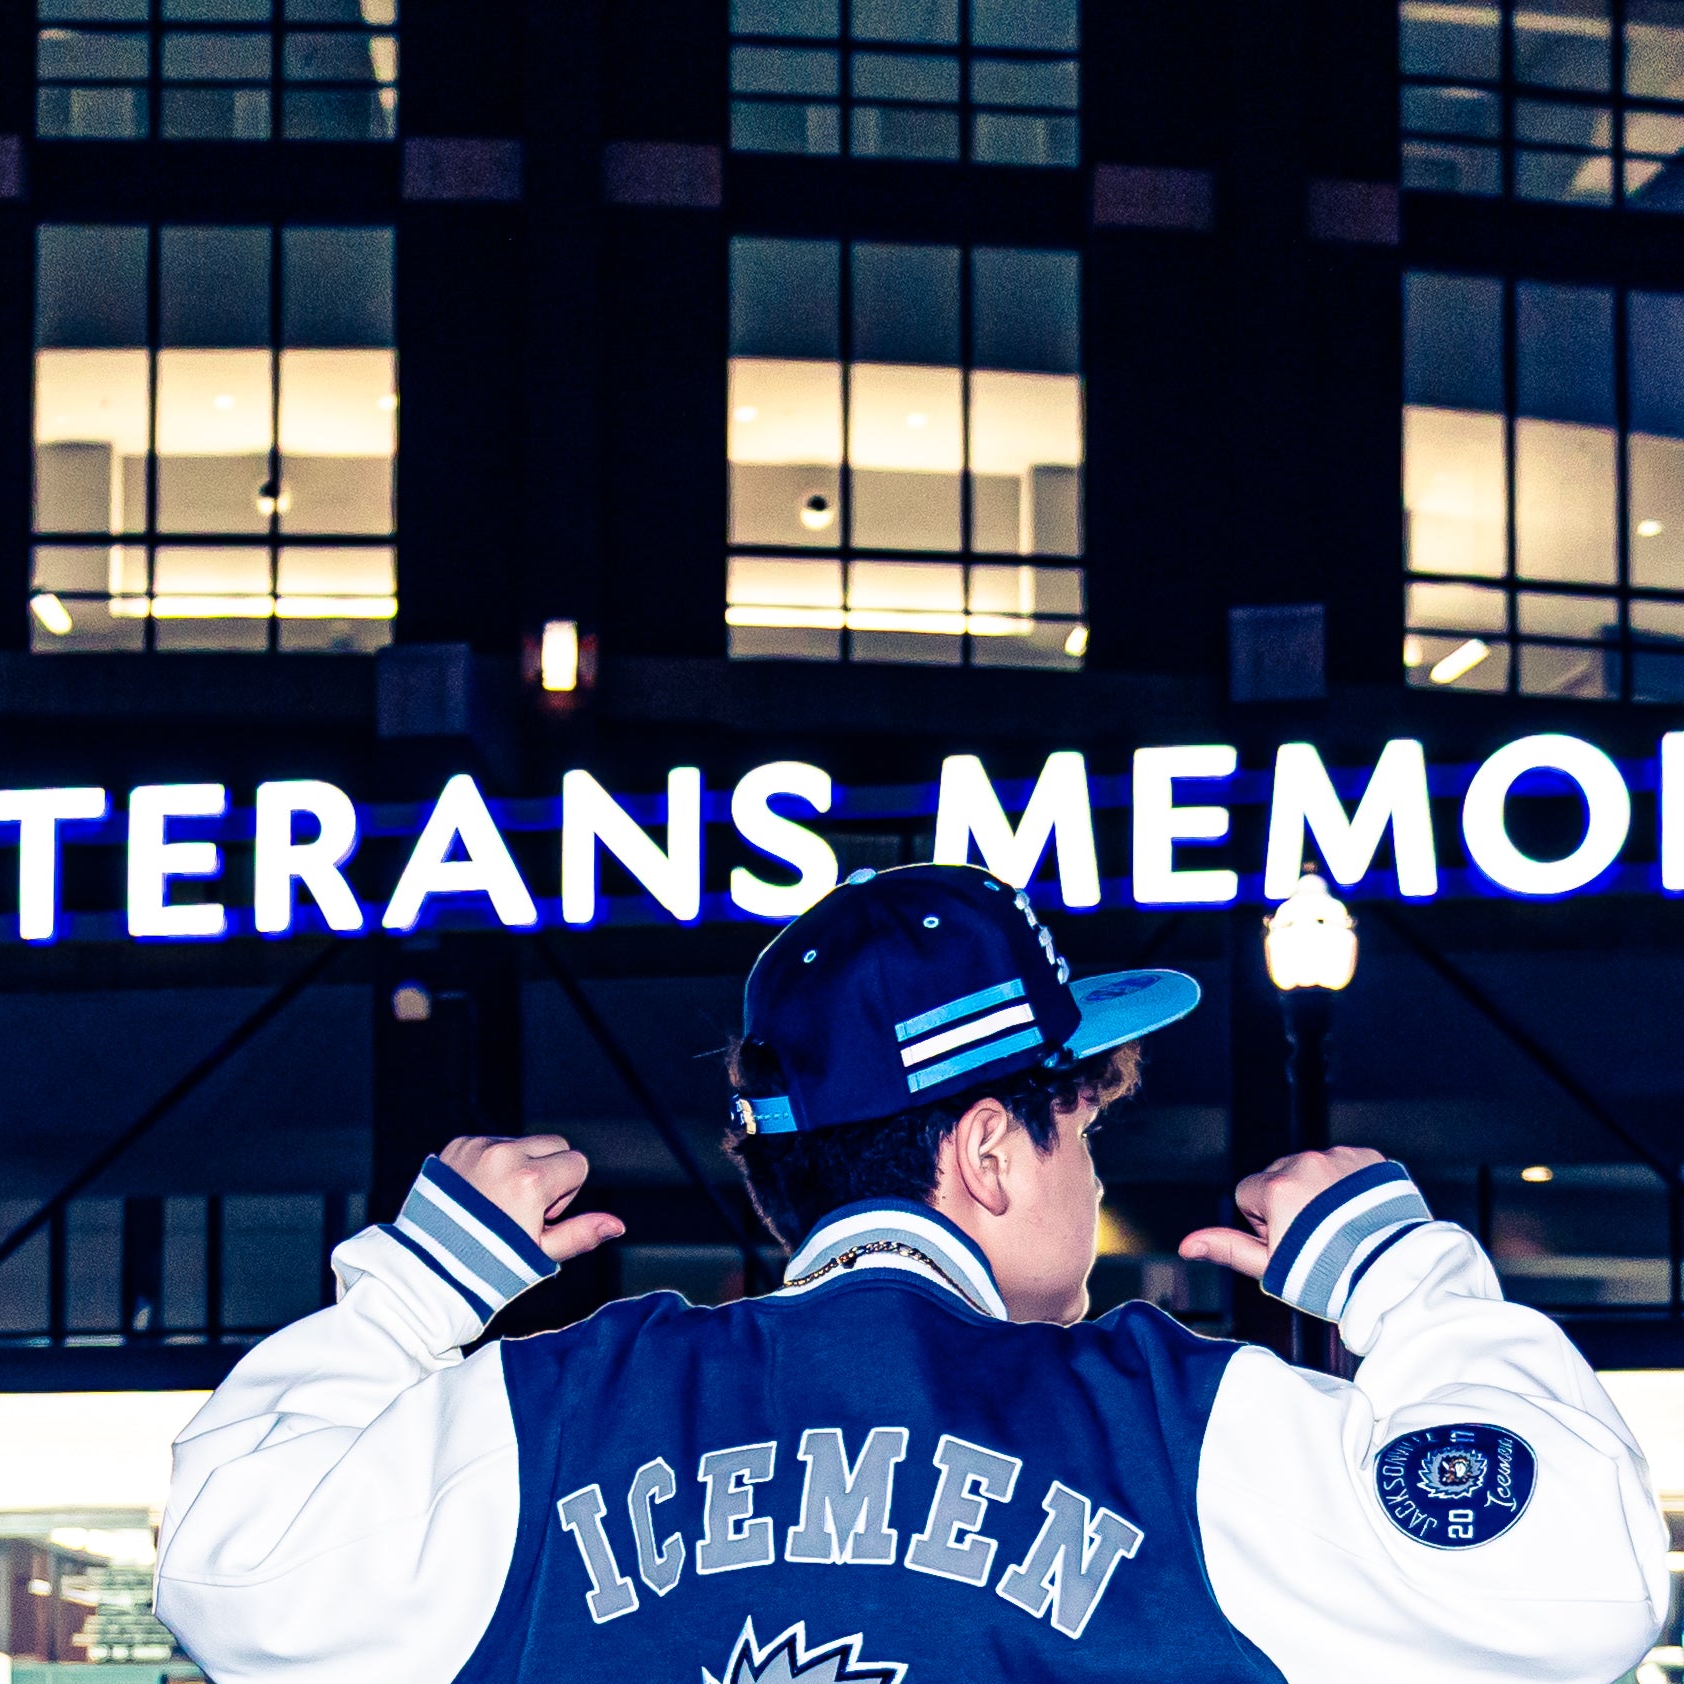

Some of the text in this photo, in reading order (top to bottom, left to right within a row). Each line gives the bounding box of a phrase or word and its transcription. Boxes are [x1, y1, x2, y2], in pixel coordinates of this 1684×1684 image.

[557, 1427, 1144, 1639] ICEMEN
[1382, 1432, 1438, 1537] JACKSONVI
[1448, 1509, 1474, 1539] 20
